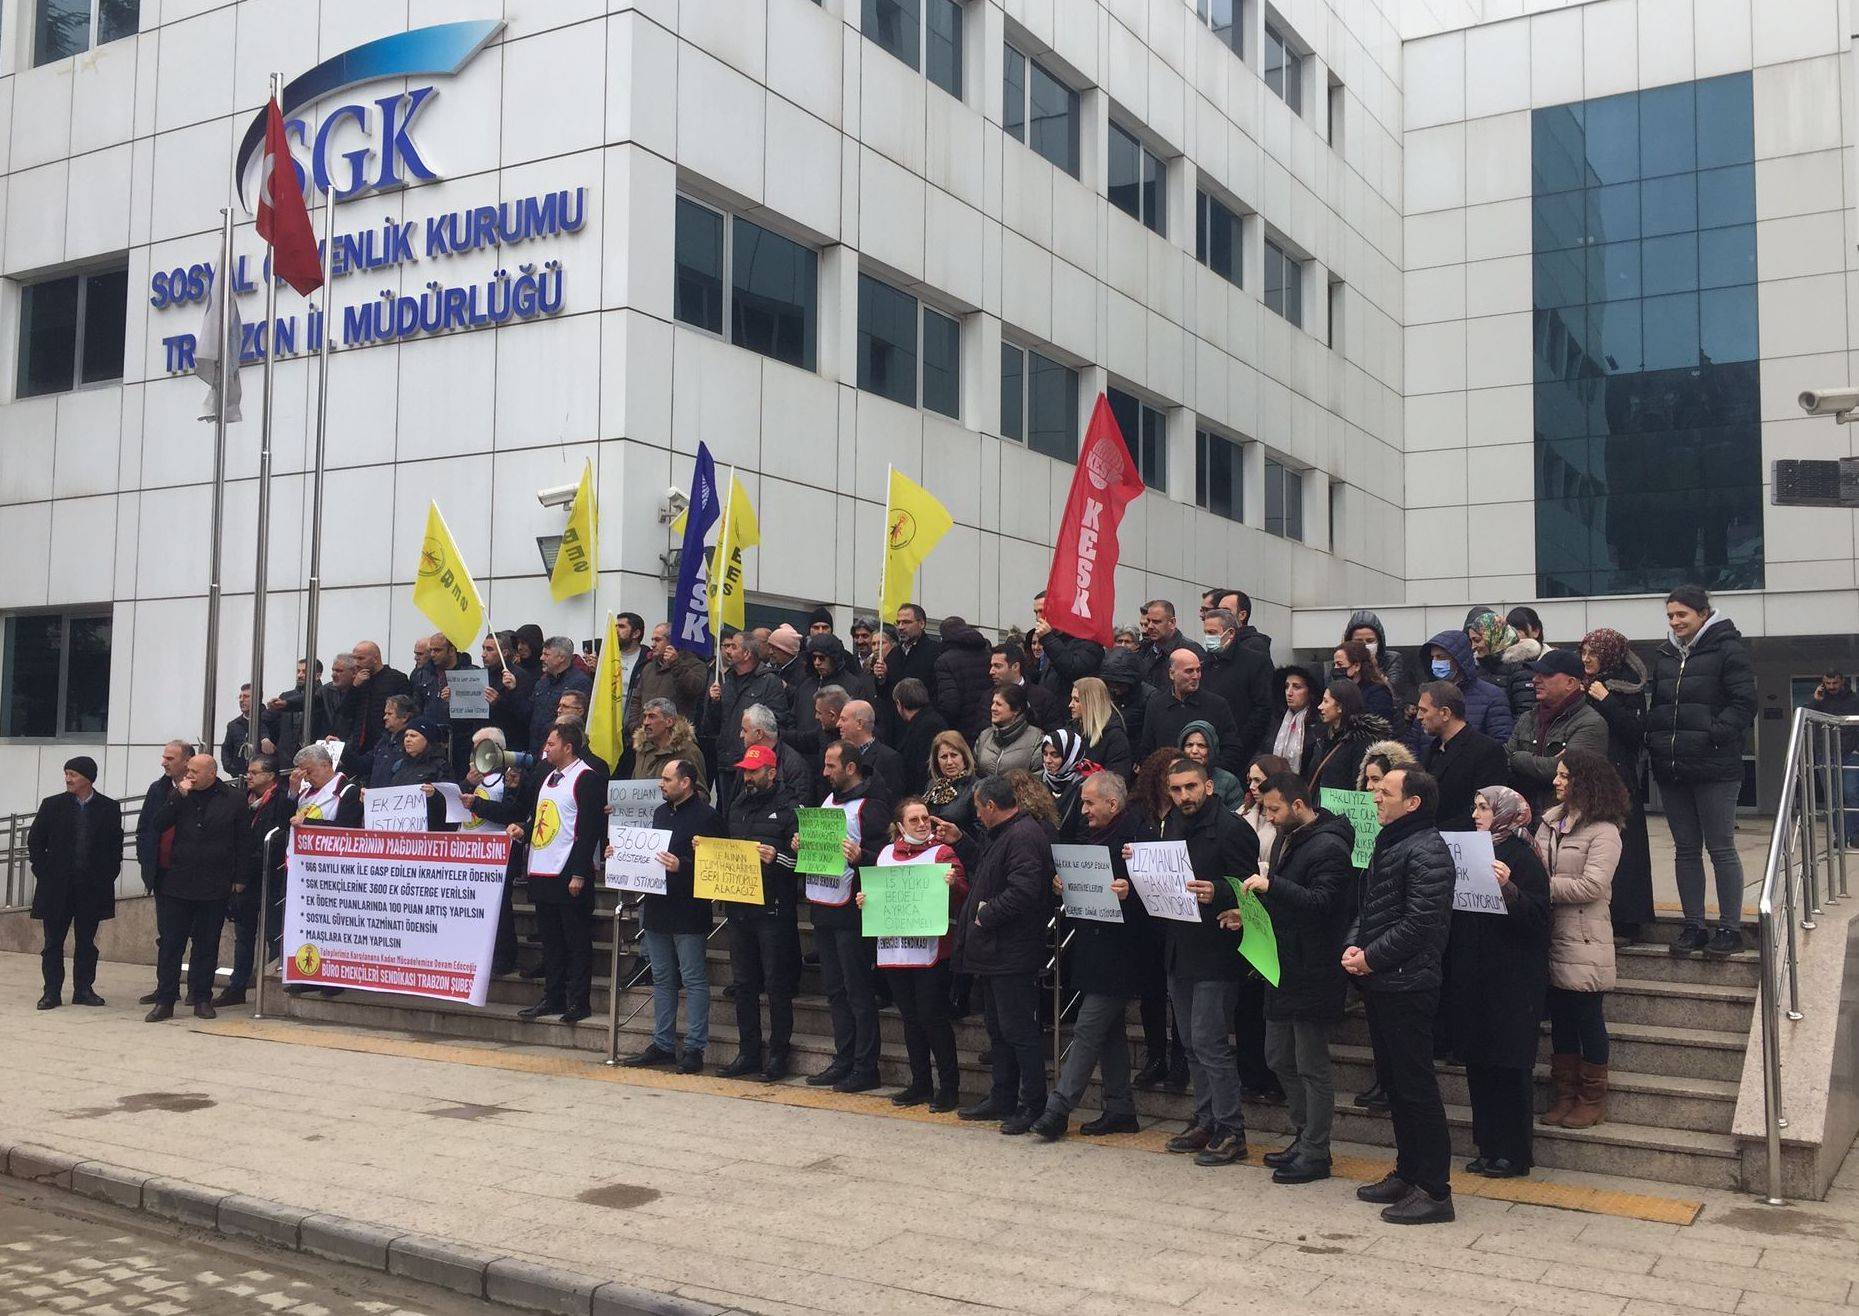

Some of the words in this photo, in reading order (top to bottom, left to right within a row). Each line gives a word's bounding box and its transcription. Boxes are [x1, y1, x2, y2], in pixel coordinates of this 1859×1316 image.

[426, 187, 584, 257] KURUMU
[162, 316, 295, 373] TRZON
[343, 259, 563, 345] MÜDÜRLÜĞÜ
[1071, 497, 1103, 619] KESK
[370, 797, 389, 813] EK
[393, 793, 426, 812] ZAM
[297, 834, 315, 850] SGK
[315, 833, 385, 855] EMEKÇİLERİNİN
[385, 834, 448, 857] MAĞDURİYETİ
[450, 836, 506, 860] GİDERİLSİN!
[614, 827, 661, 851] 3600
[318, 862, 339, 874] SAYILI
[340, 864, 355, 875] KHK
[356, 862, 368, 876] İLE
[370, 865, 389, 877] GASP
[390, 864, 417, 879] EDİLEN
[418, 865, 468, 881] İKRAMİYELER
[469, 868, 504, 883] ÖDENSİN
[306, 878, 319, 890] SGK
[319, 878, 368, 894] EMEKÇİLERİNE
[369, 884, 388, 895] 3600
[389, 884, 399, 896] EK
[400, 883, 439, 898] GÖSTERGE
[440, 886, 476, 900] VERİLSİN
[306, 895, 315, 906] EK
[316, 894, 338, 909] ÖDEME
[339, 898, 388, 913] PUANLARINDA
[389, 902, 401, 913] 100
[403, 903, 424, 915] PUAN
[424, 905, 448, 919] ARTIŞ
[449, 907, 485, 920] YAPILSIN
[306, 912, 331, 926] SOSYAL
[332, 912, 365, 928] GÜVENLİK
[366, 917, 404, 931] TAZMİNATI
[405, 920, 438, 934] ÖDENSİN
[305, 929, 342, 944] MAAŞLARA
[343, 933, 353, 944] EK
[353, 934, 368, 946] ZAM
[369, 934, 401, 949] YAPILSIN
[321, 960, 340, 978] BÜRO
[340, 963, 380, 983] EMEKÇİLERİ
[380, 968, 416, 987] SENDİKASI
[418, 973, 450, 989] TRABZON
[450, 976, 474, 995] ŞUBES
